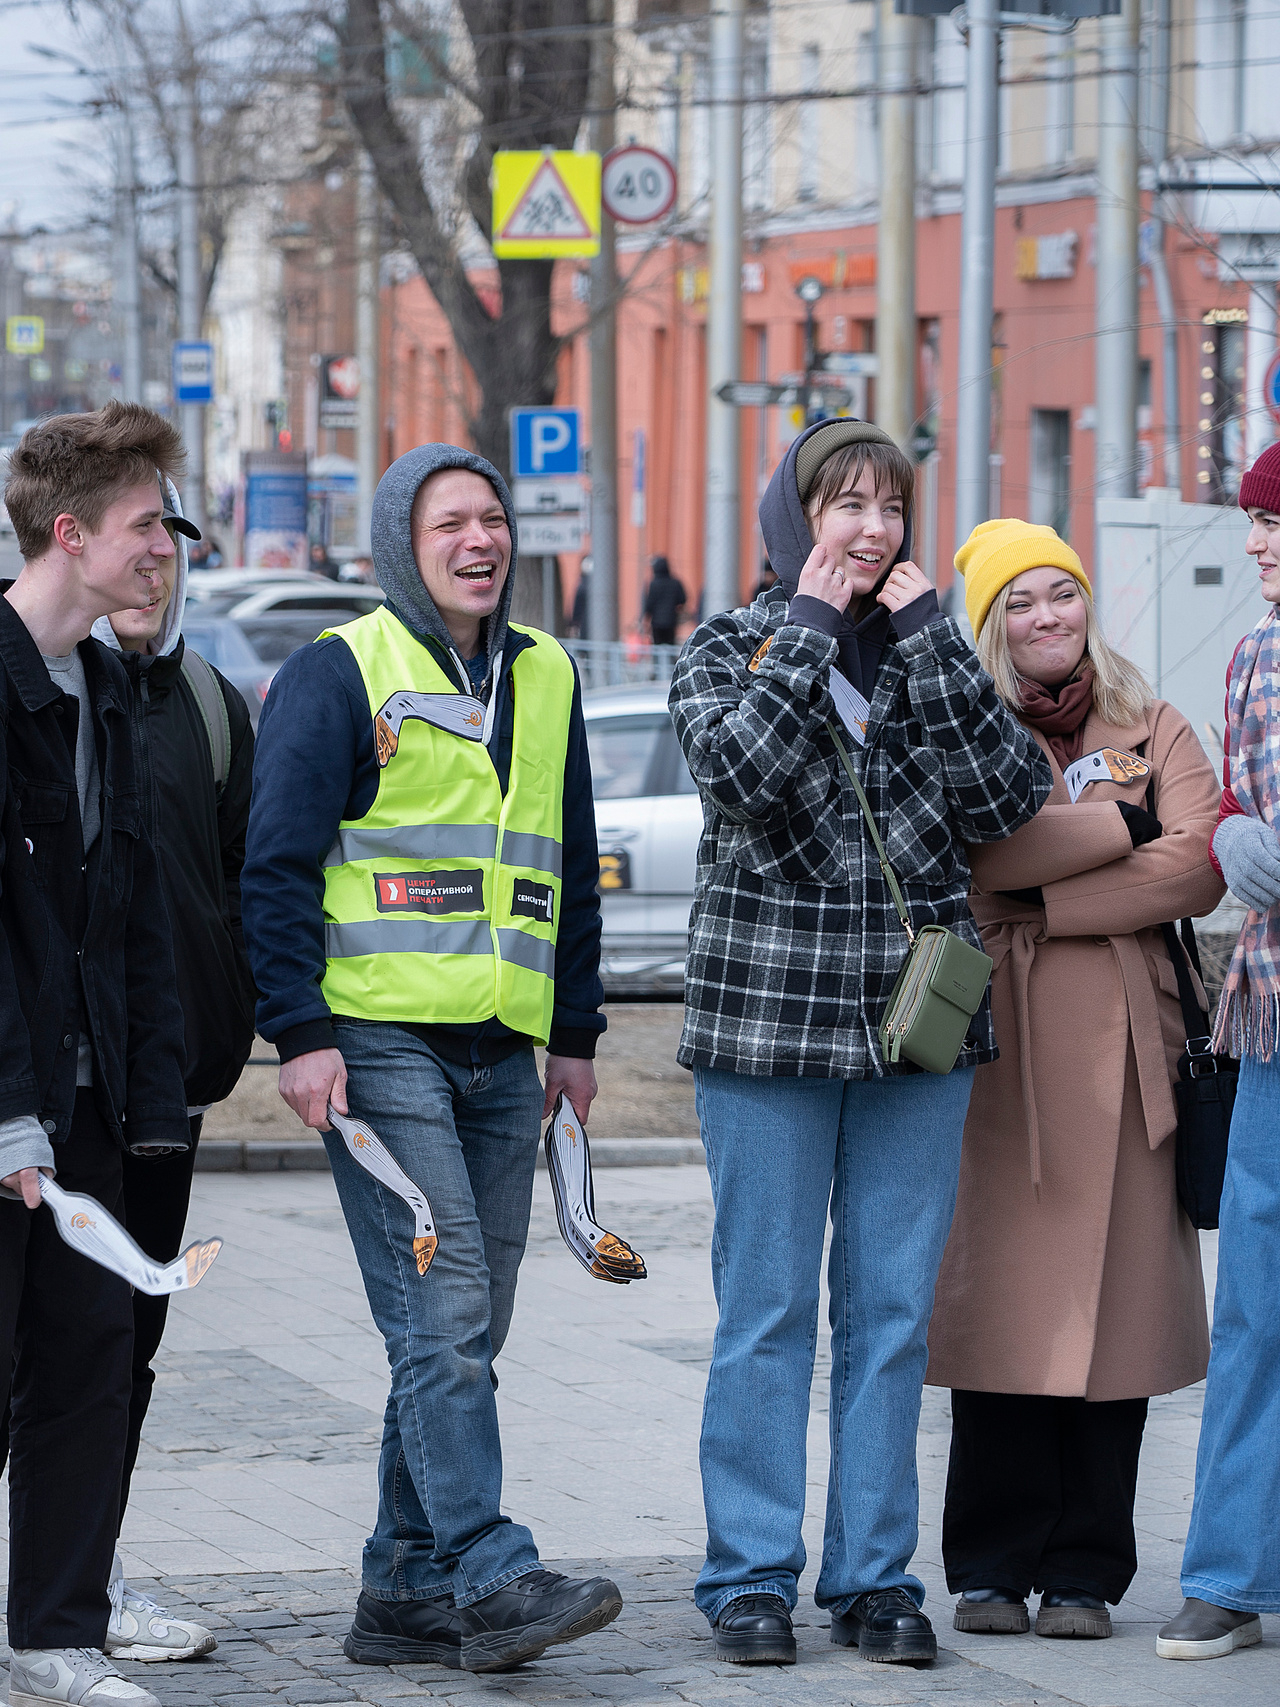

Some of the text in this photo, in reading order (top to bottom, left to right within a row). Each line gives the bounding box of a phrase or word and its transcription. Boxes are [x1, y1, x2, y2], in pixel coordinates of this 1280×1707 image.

[613, 167, 662, 201] 40
[530, 415, 571, 472] P
[407, 879, 436, 887] ЦЕНТР
[408, 885, 473, 896] ОПЕРАТИВНОЙ
[409, 896, 444, 904] ПЕЧАТИ
